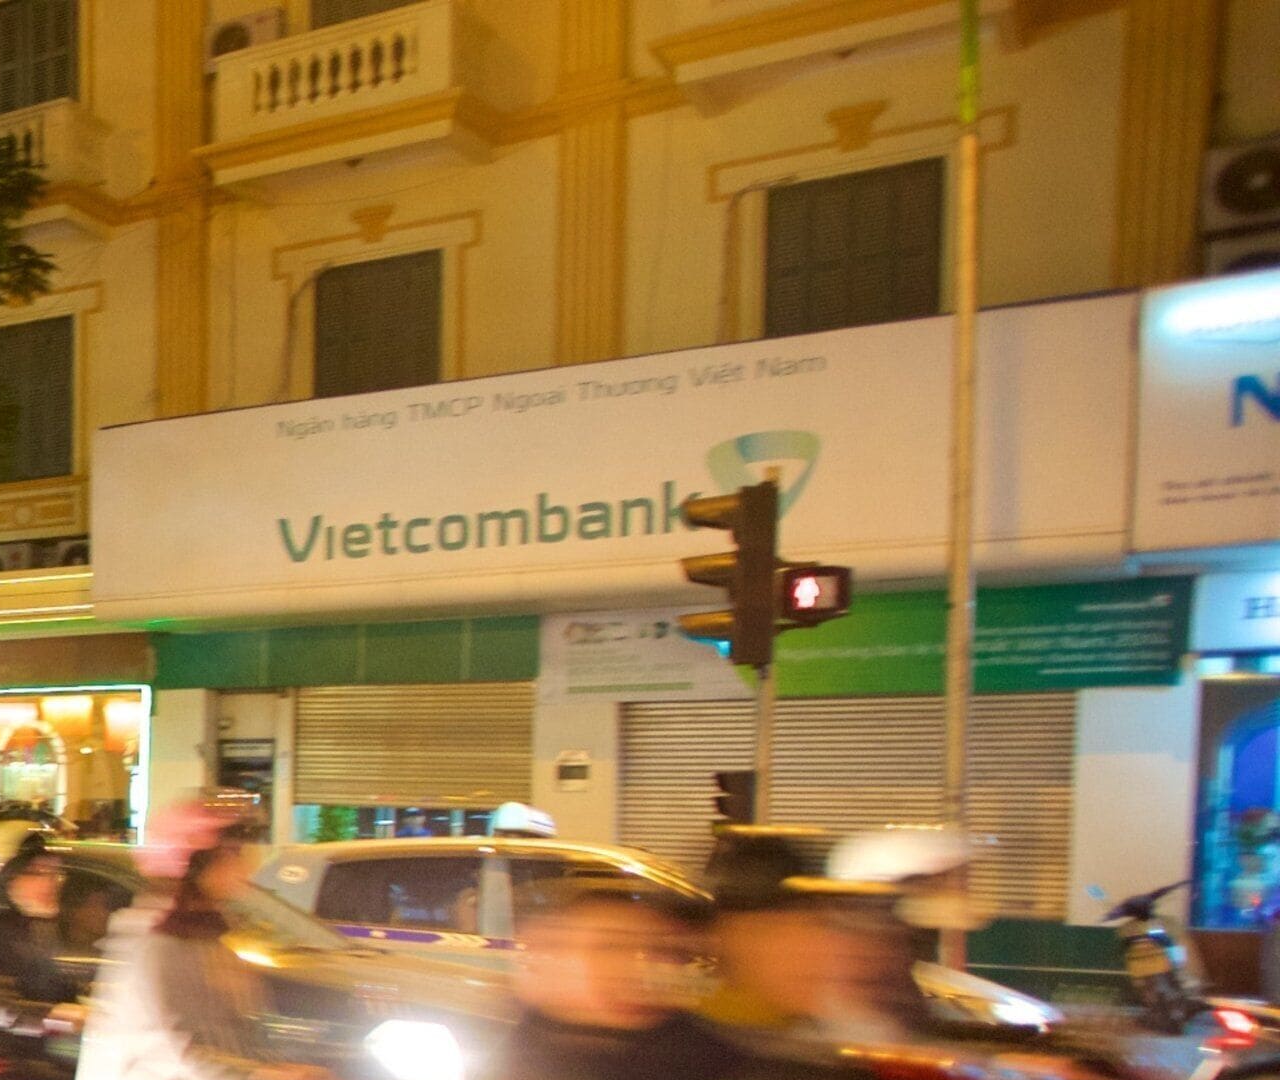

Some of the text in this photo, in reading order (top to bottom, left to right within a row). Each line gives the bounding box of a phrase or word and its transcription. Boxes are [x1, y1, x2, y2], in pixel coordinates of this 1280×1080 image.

[406, 395, 485, 423] TMCP
[753, 354, 828, 380] Nam
[277, 480, 704, 563] Vietcombank
